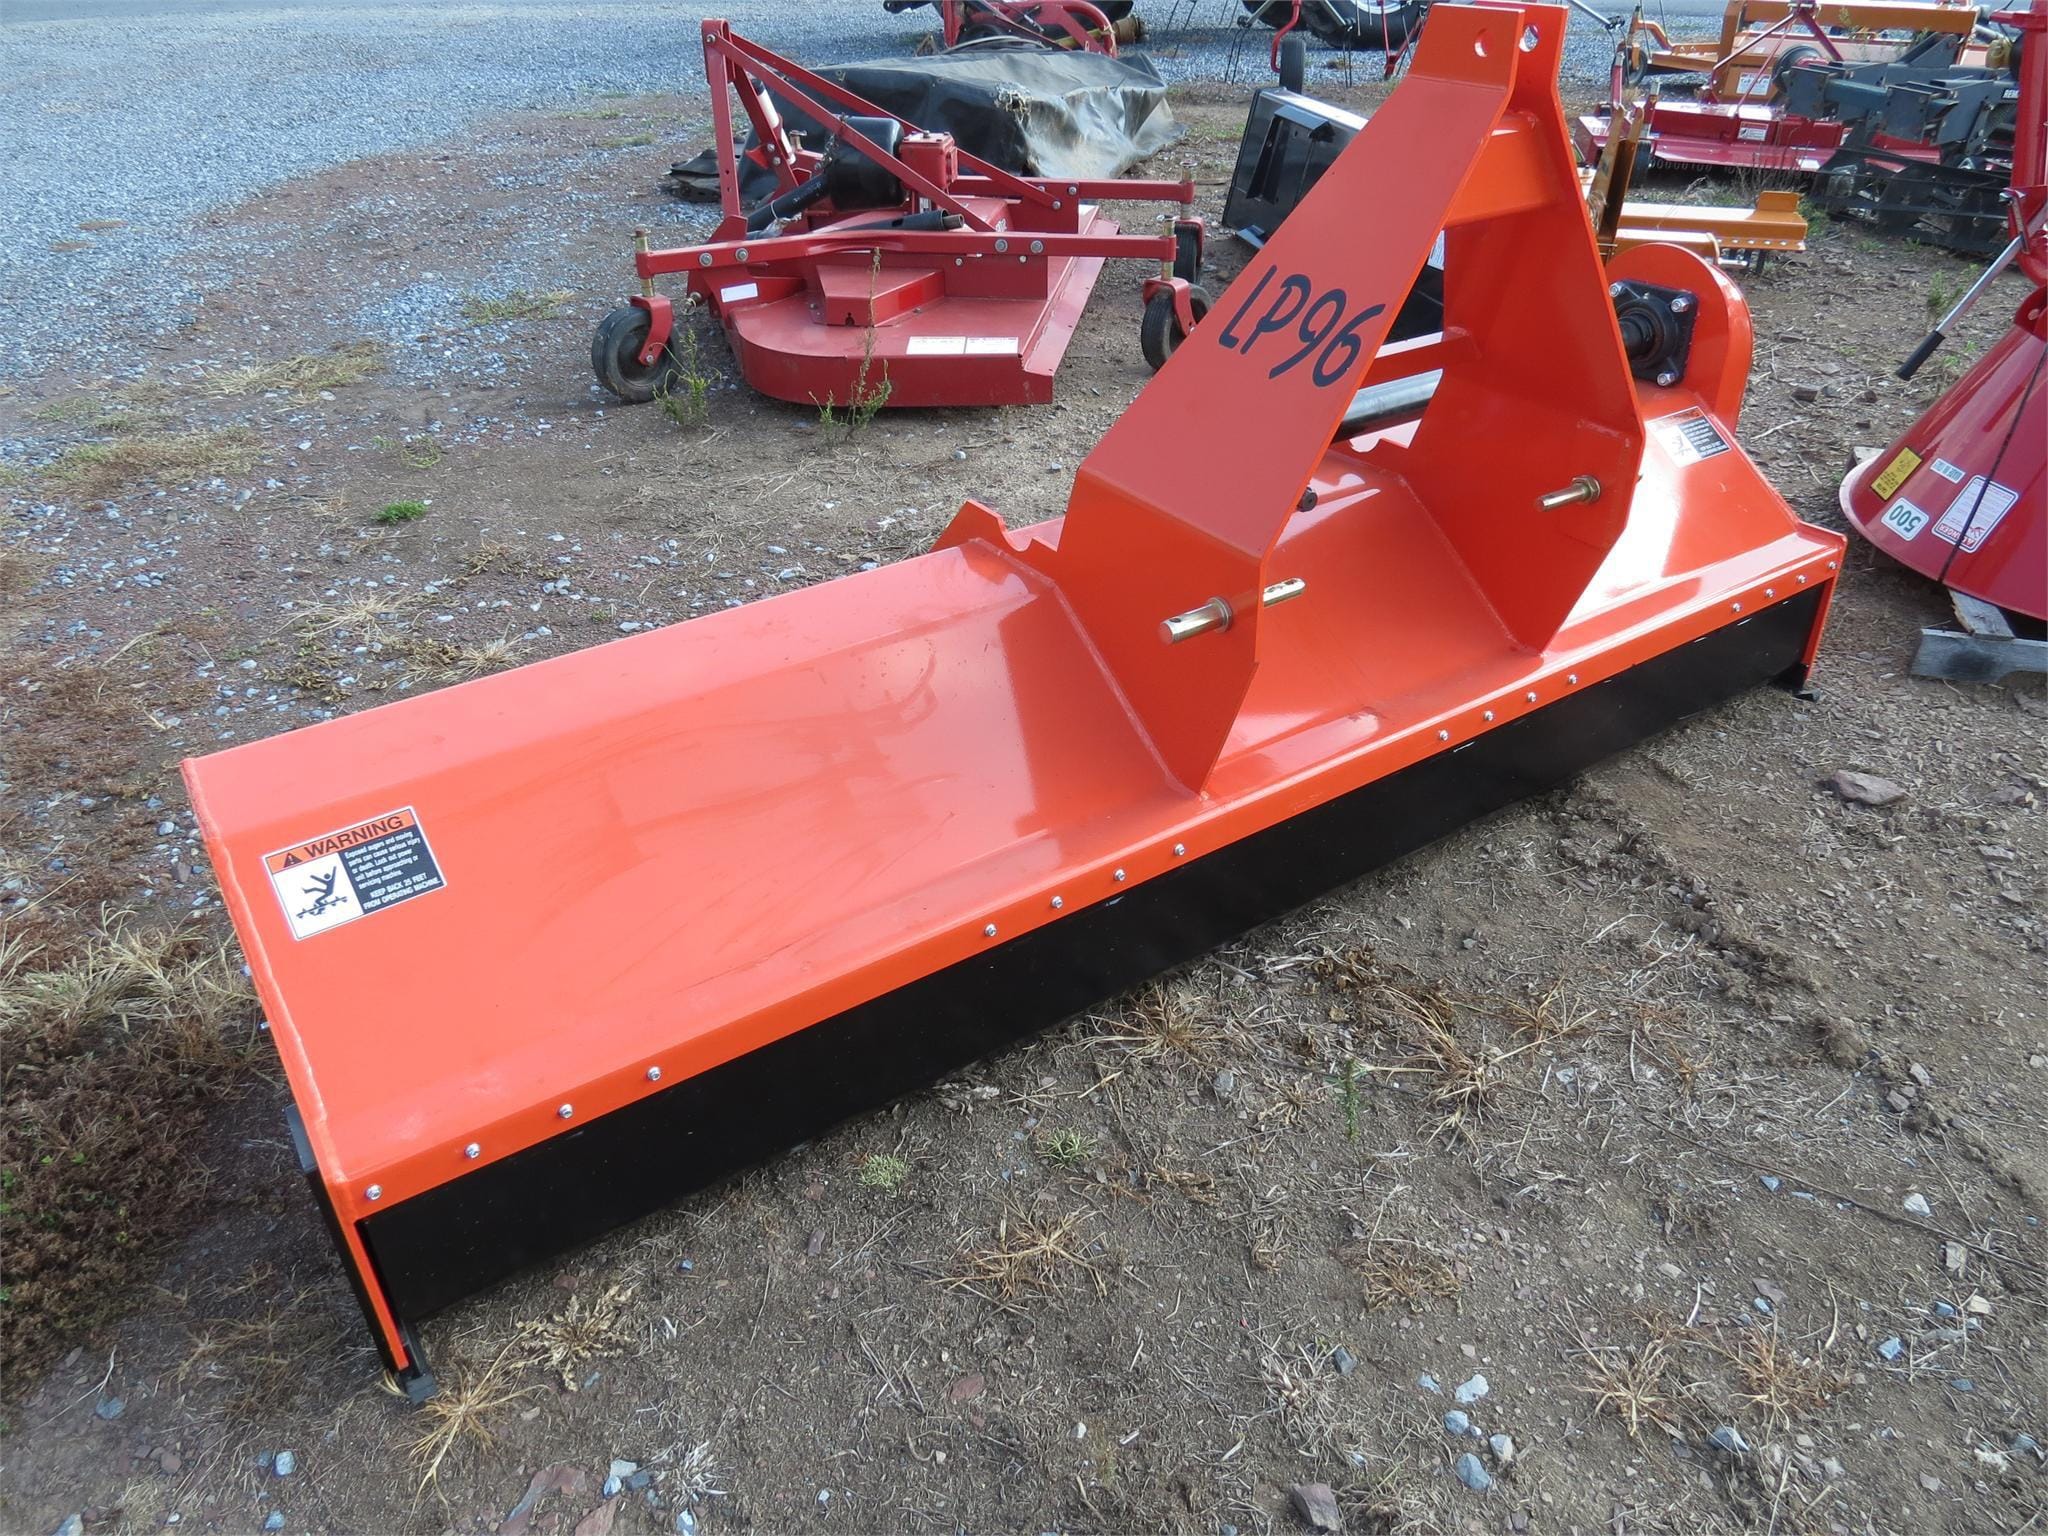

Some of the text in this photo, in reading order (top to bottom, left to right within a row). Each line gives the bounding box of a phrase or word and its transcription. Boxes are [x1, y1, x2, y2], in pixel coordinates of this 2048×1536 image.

[1219, 265, 1386, 388] LP96
[1889, 505, 1922, 533] 500
[304, 816, 403, 857] WARNING
[344, 846, 367, 859] Exposed
[395, 832, 413, 841] moving
[348, 858, 362, 867] parts
[373, 849, 388, 857] cause
[388, 842, 407, 852] serious
[374, 857, 388, 866] Lock
[397, 849, 412, 858] power
[359, 870, 403, 889] servicing machine.
[364, 869, 382, 878] before
[382, 858, 412, 871] approaching
[363, 877, 441, 909] FROM OPERATING MACHINE.
[370, 873, 427, 898] KEEP BACK 25 FEET
